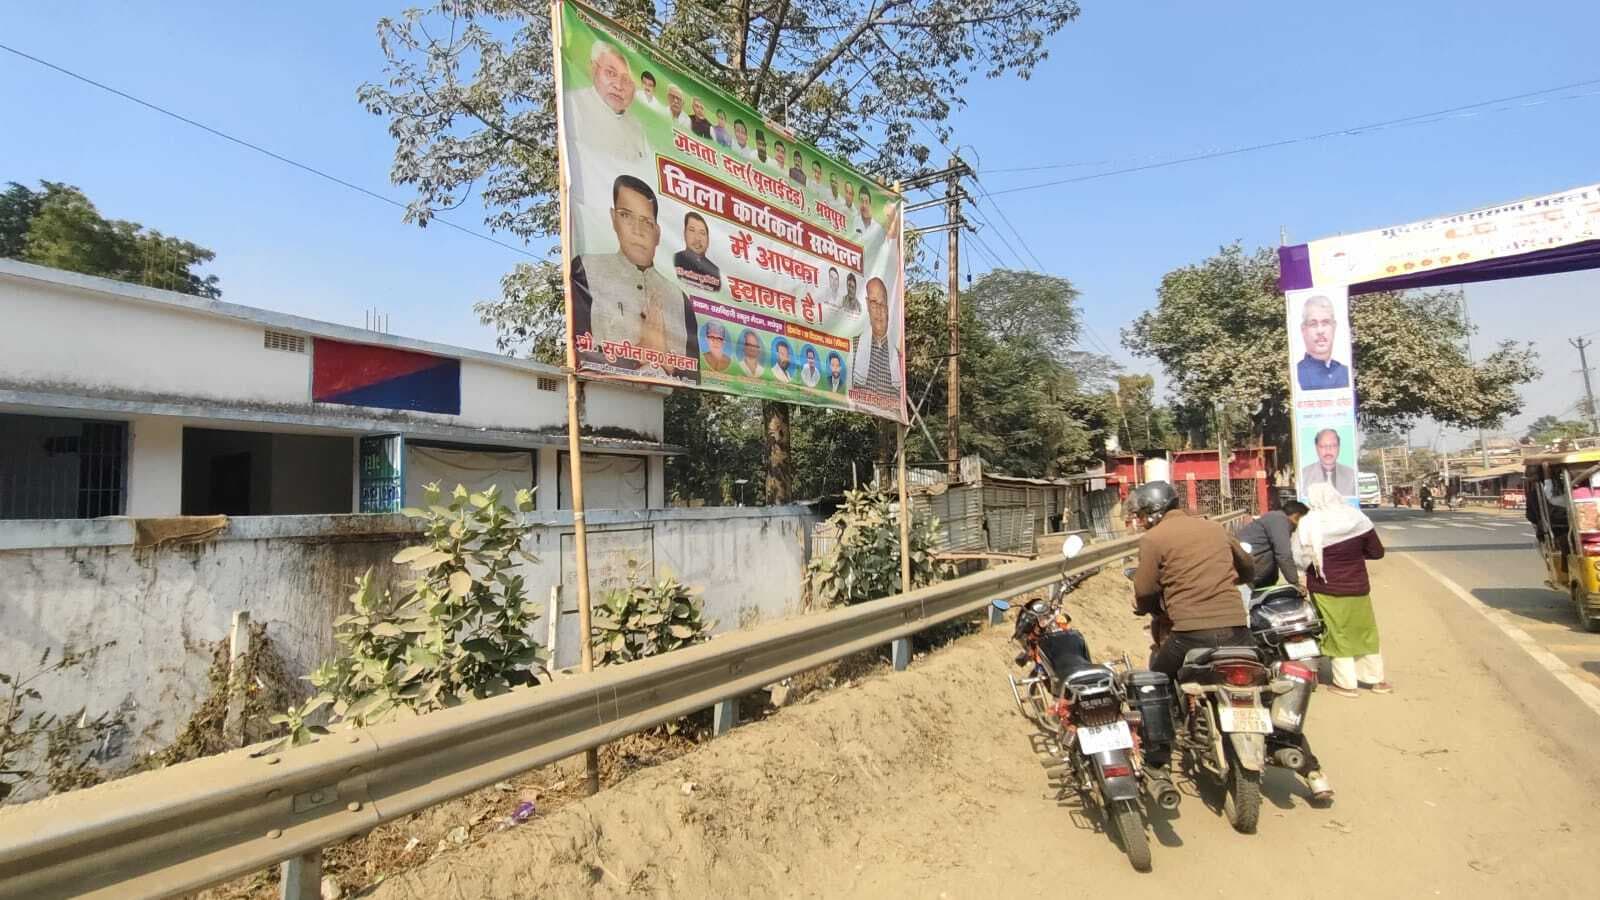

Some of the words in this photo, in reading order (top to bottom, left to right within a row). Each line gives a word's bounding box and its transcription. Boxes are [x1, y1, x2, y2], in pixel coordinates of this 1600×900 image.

[673, 128, 719, 169] जनता
[662, 164, 726, 213] जिला
[731, 196, 804, 247] कार्यकर्ता
[808, 231, 861, 270] सम्मेलन
[729, 231, 753, 263] में
[756, 245, 819, 287] आपका
[727, 275, 797, 315] स्वागत
[602, 340, 642, 362] सुजीत
[665, 352, 698, 371] मेहता
